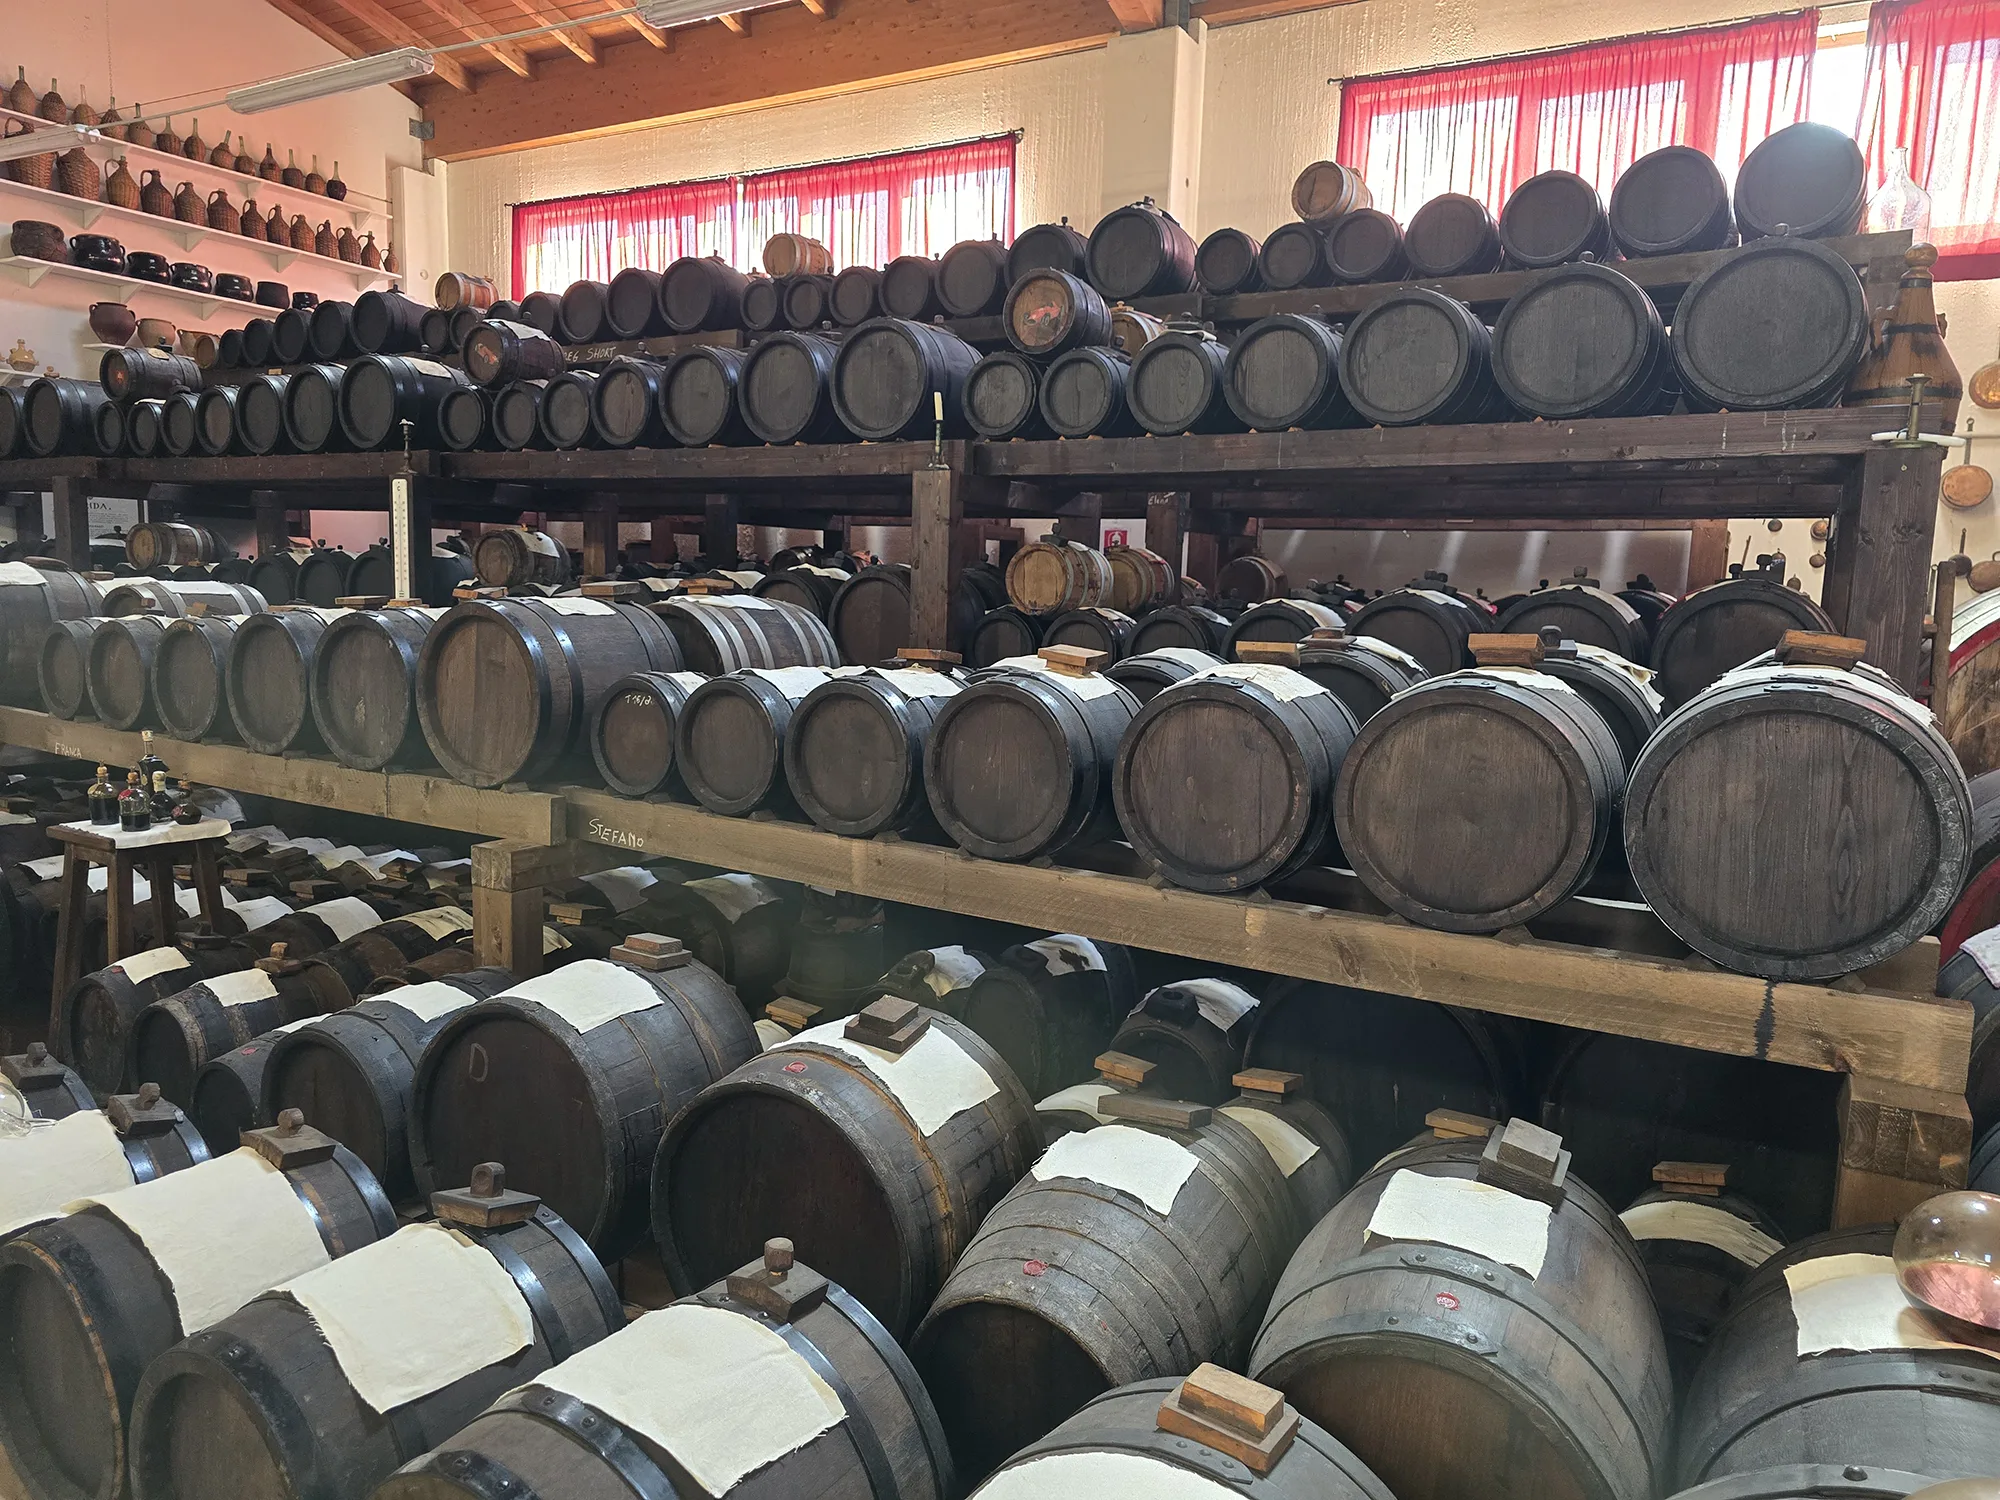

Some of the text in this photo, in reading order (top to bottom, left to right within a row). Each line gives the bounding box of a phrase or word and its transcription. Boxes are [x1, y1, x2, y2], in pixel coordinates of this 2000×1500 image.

[586, 346, 617, 361] SHORT
[588, 818, 645, 848] STEFANO
[468, 1042, 489, 1083] D
